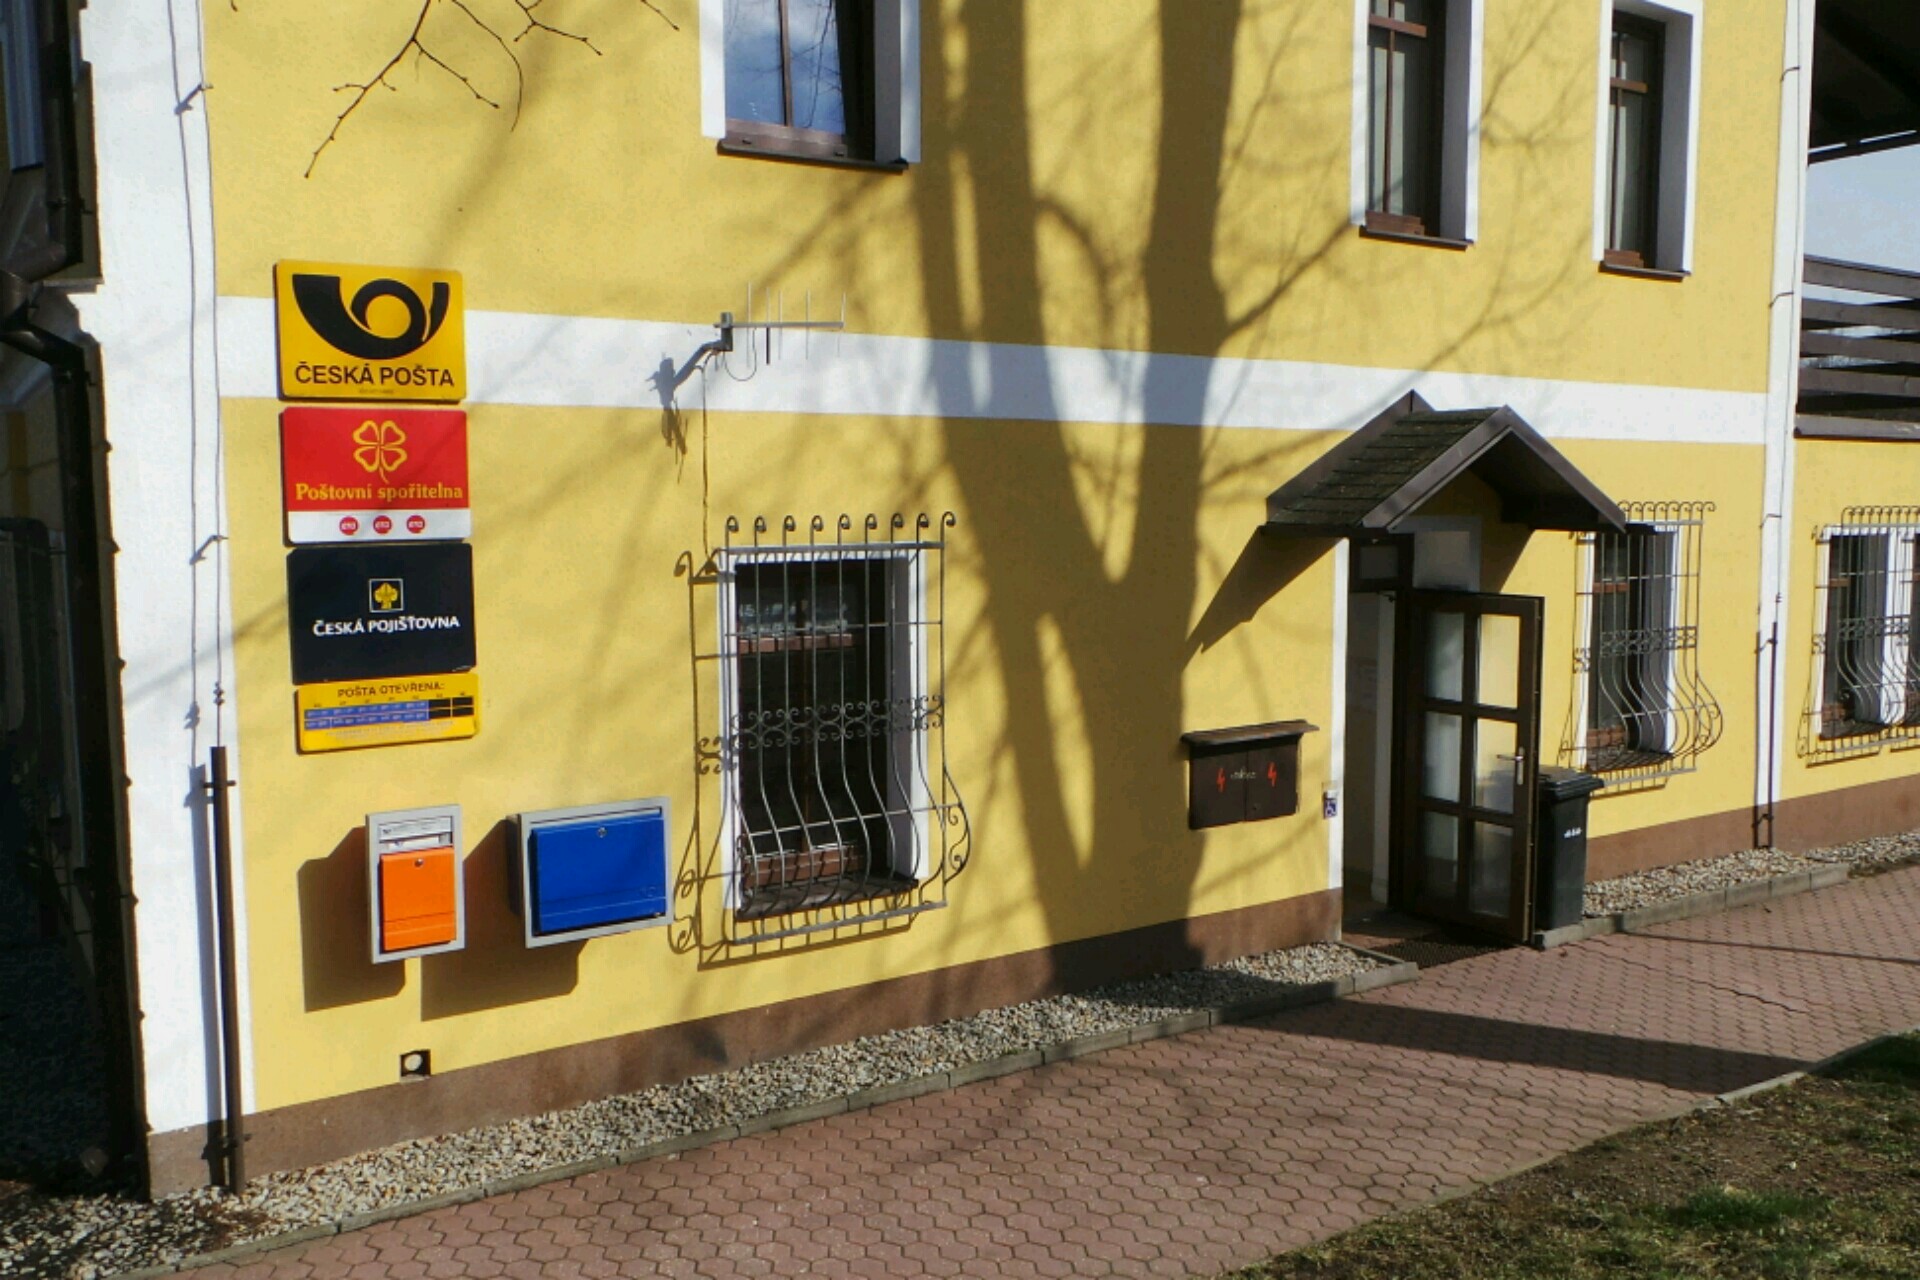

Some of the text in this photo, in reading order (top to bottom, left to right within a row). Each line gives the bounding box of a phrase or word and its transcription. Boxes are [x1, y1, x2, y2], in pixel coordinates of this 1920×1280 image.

[295, 361, 455, 388] ČESKÁ POŠTA
[295, 482, 463, 502] Poštovní spořitelna
[312, 618, 365, 637] ČESKÁ
[337, 685, 376, 698] POŠTA
